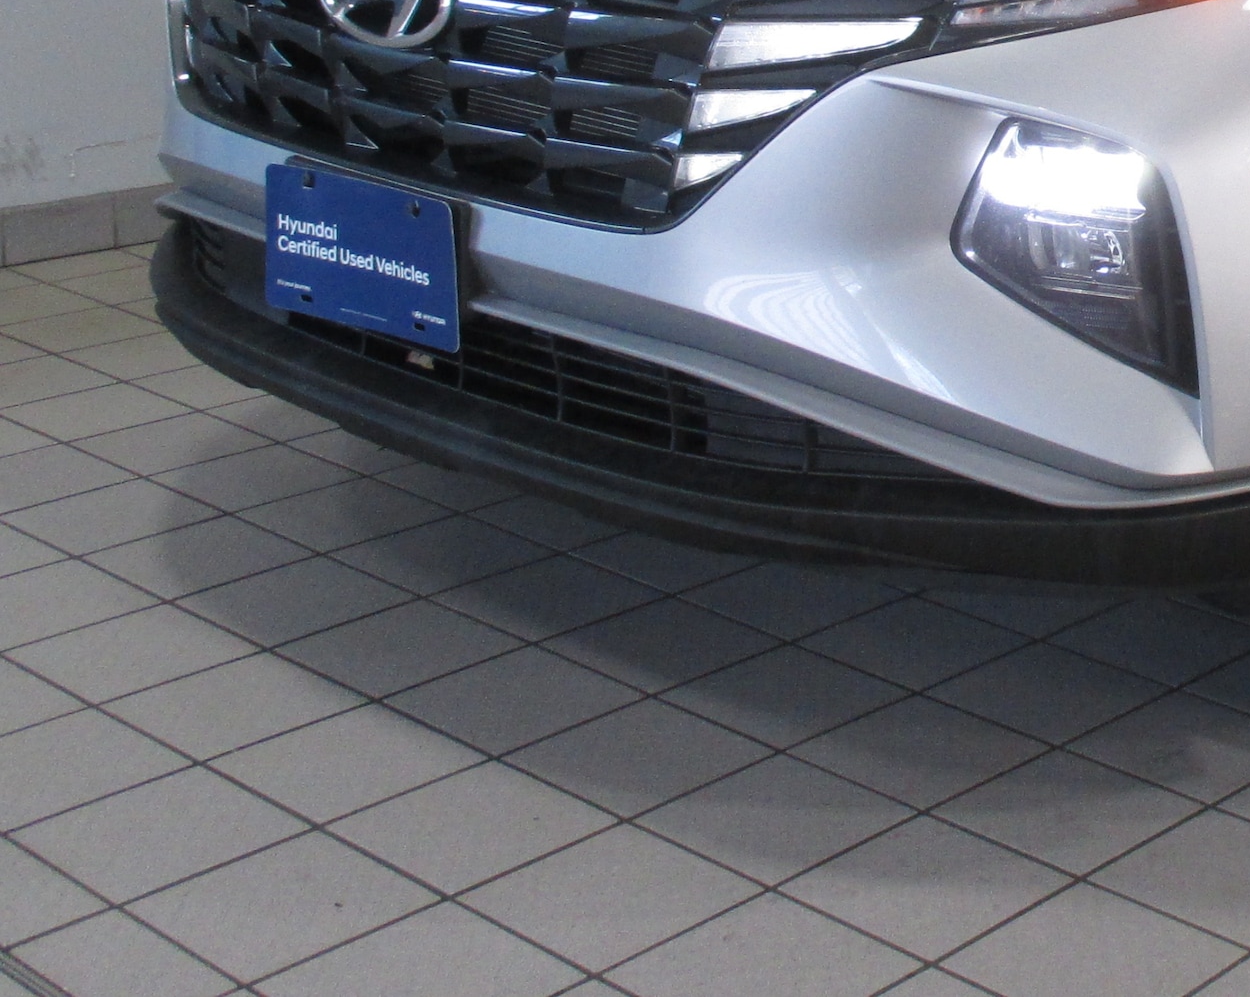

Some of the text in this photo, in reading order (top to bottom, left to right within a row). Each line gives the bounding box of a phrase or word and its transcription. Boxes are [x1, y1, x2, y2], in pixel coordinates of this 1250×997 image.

[278, 213, 338, 241] Hyundai
[277, 235, 431, 286] Certified Used Vehicles
